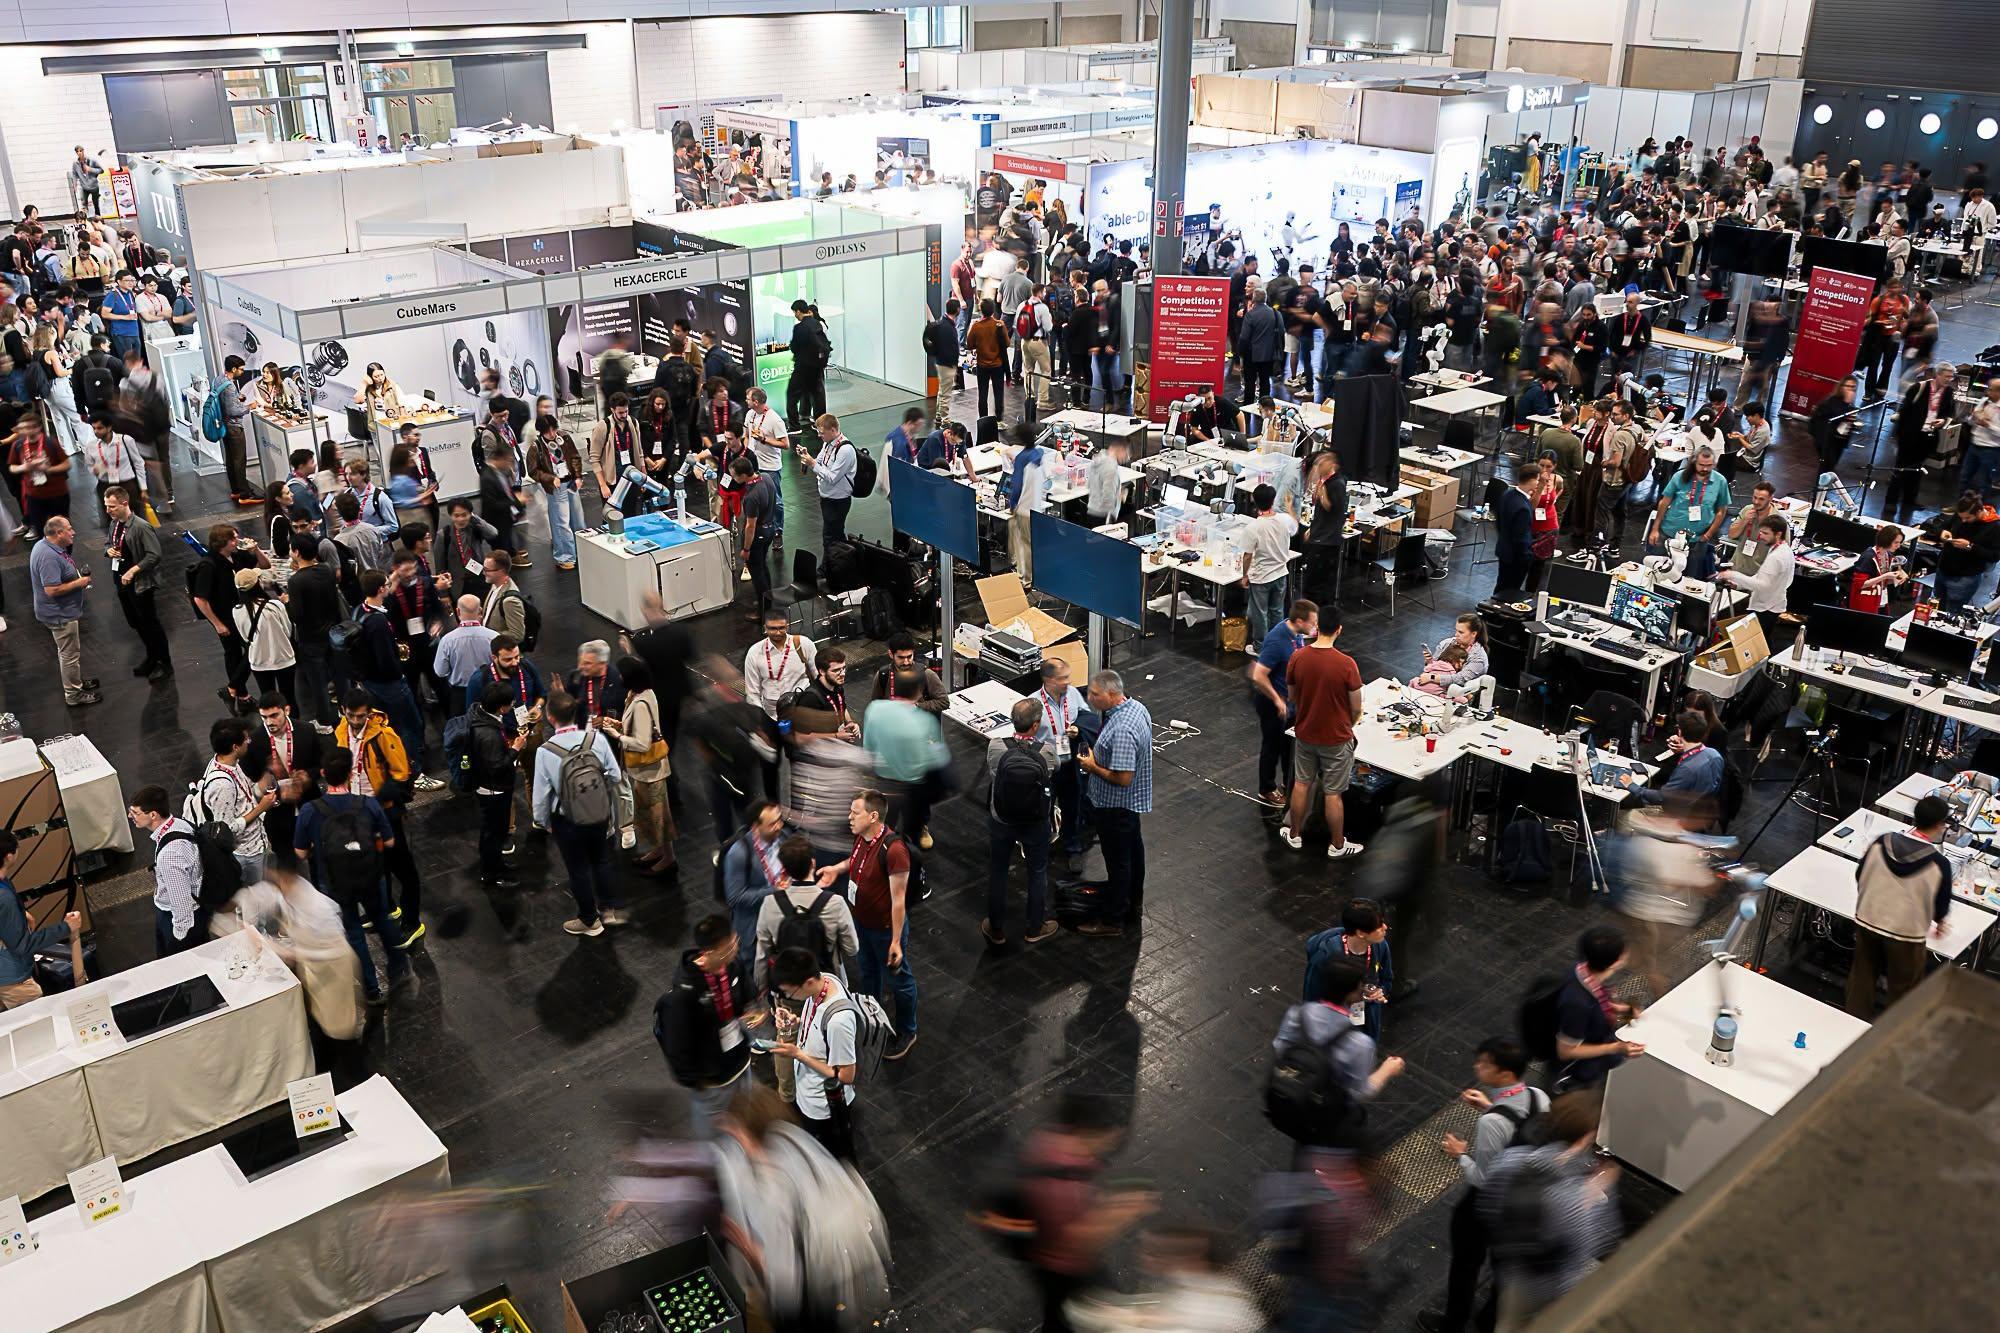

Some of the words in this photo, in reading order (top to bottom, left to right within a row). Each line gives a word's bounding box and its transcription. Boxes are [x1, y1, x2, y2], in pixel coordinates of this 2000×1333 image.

[827, 241, 866, 257] DELSYS
[515, 254, 564, 267] HEXACERCLE
[931, 241, 941, 285] HEBI
[614, 267, 688, 288] HEXACERCLE
[1160, 295, 1216, 307] Competition
[1217, 297, 1223, 306] 1
[1813, 287, 1859, 304] Competition
[1859, 297, 1866, 305] 2
[237, 296, 262, 317] CubeMars
[396, 301, 457, 319] CubeMars
[429, 440, 461, 453] beMars
